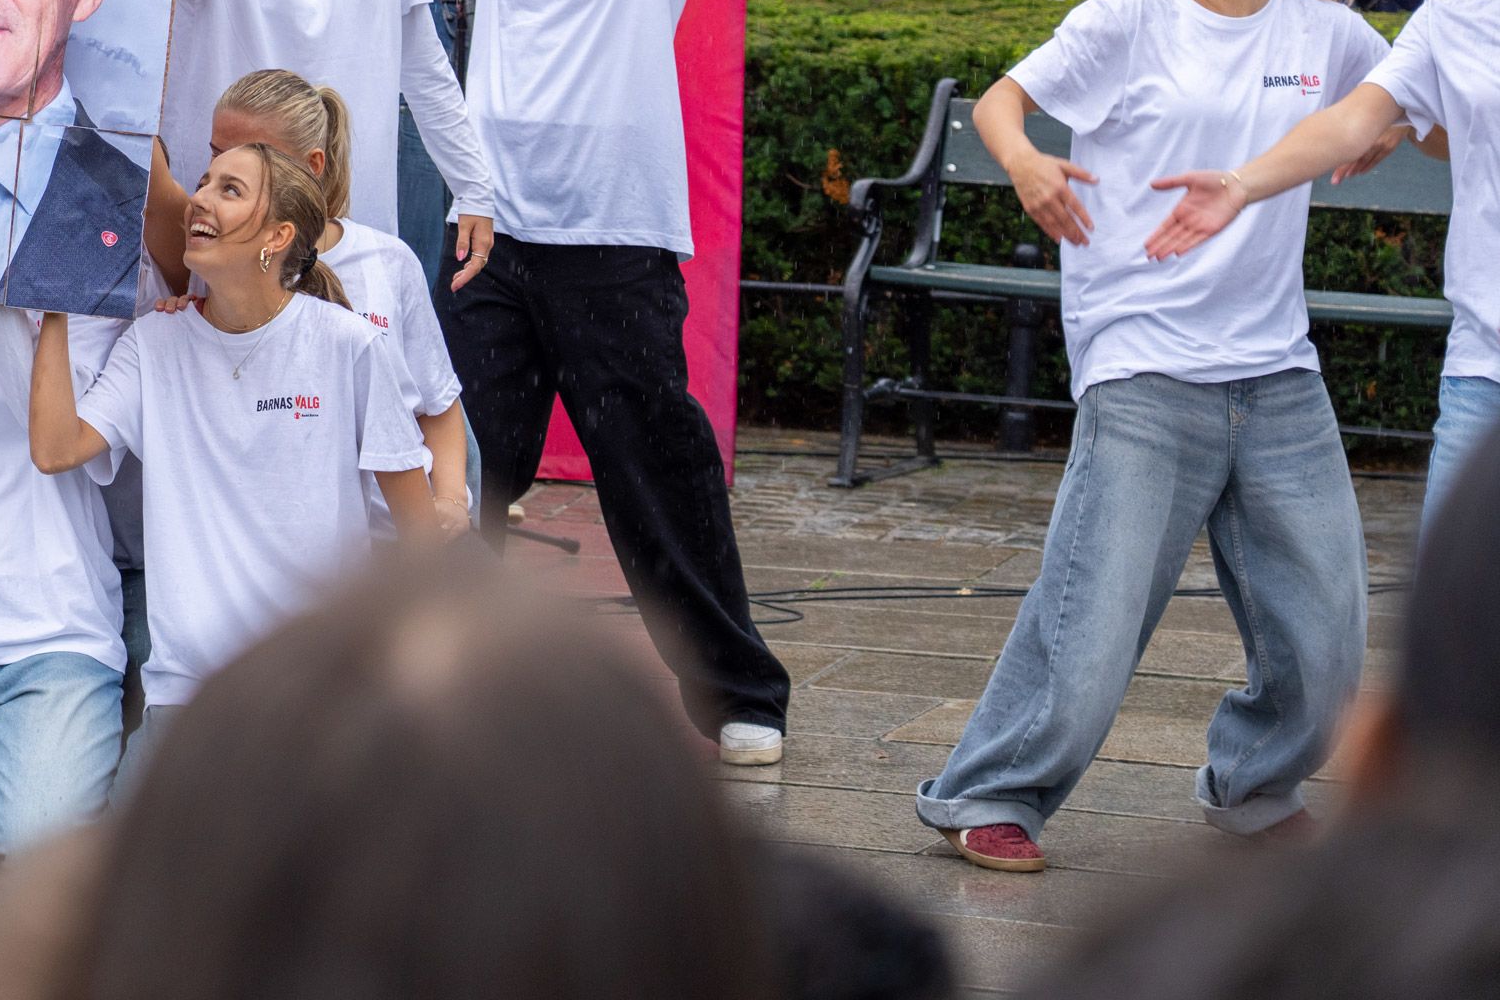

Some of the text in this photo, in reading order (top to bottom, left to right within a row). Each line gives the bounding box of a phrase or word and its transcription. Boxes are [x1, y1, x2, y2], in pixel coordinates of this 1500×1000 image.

[1263, 73, 1320, 87] BARNAS VALG
[369, 312, 389, 329] VALG
[257, 395, 320, 412] BARNAS VALG
